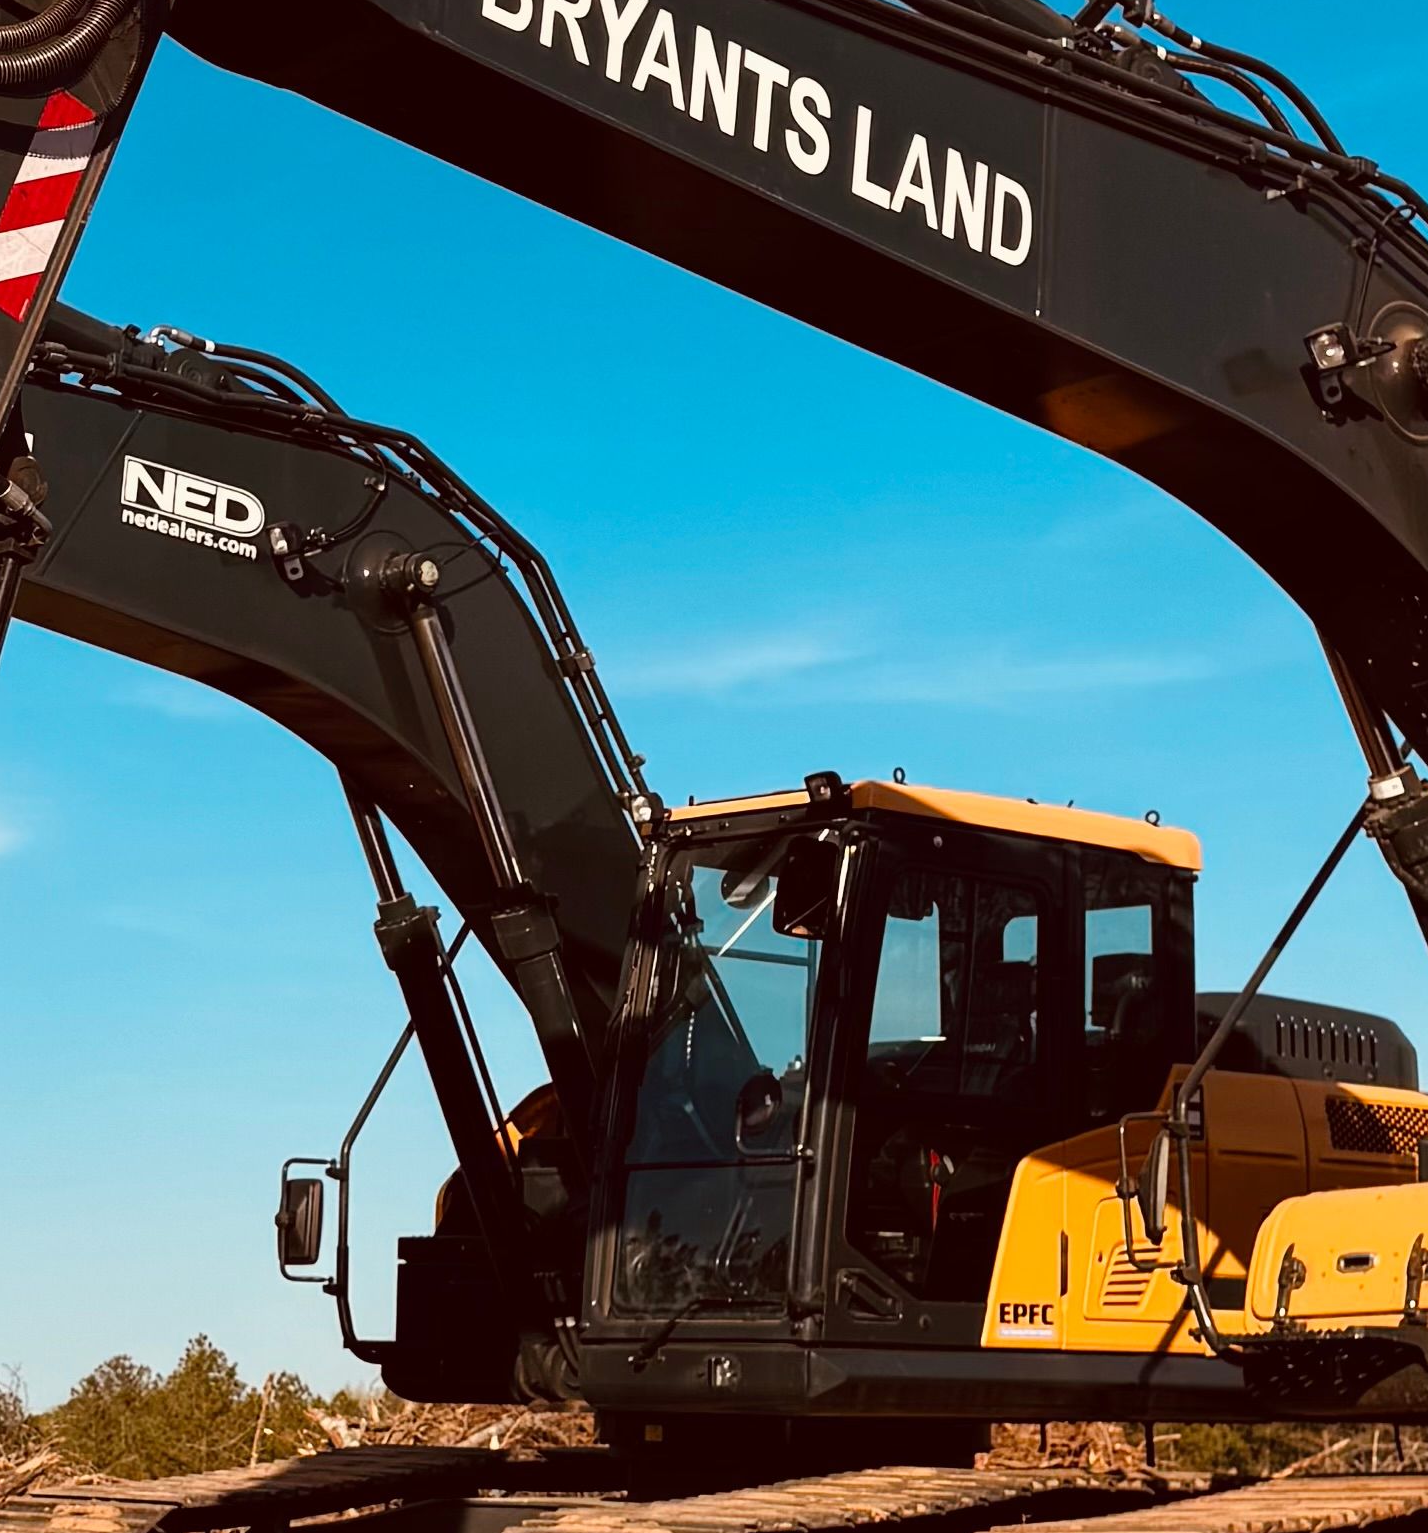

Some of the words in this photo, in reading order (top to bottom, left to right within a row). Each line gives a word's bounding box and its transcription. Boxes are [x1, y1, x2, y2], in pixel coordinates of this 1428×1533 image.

[849, 104, 1034, 267] LAND
[122, 458, 264, 537] NED
[120, 508, 258, 562] nedealers.com
[999, 1302, 1054, 1326] EPFC
